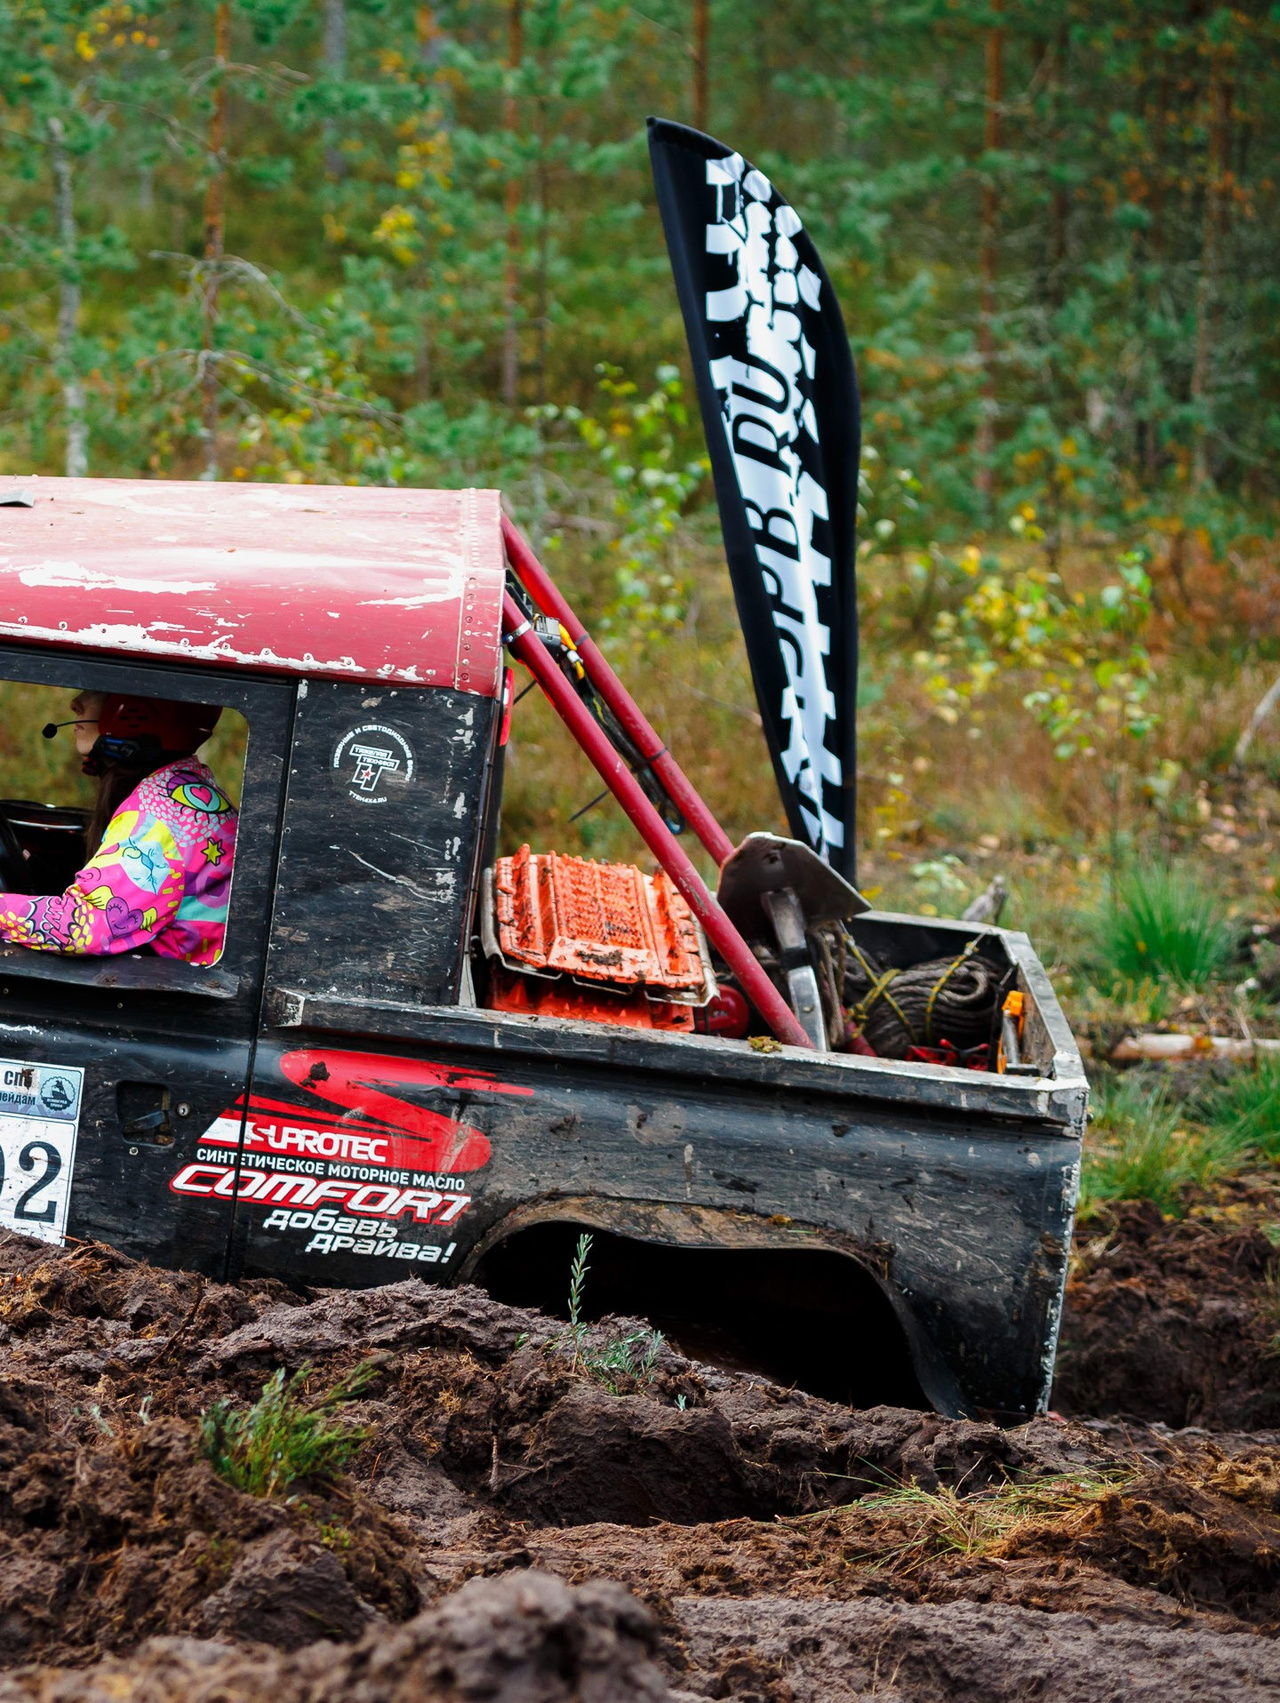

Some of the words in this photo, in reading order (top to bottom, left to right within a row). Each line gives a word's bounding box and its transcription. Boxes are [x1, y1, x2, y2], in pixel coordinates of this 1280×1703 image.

[3, 1069, 33, 1088] СП
[196, 1147, 324, 1176] СИНТЕТИЧЕСКОЕ
[327, 1163, 409, 1185] МОТОРНОЕ
[412, 1173, 466, 1191] МАСЛО
[171, 1164, 472, 1223] COMFORT
[263, 1208, 399, 1239] добавь
[304, 1232, 458, 1264] драйва!
